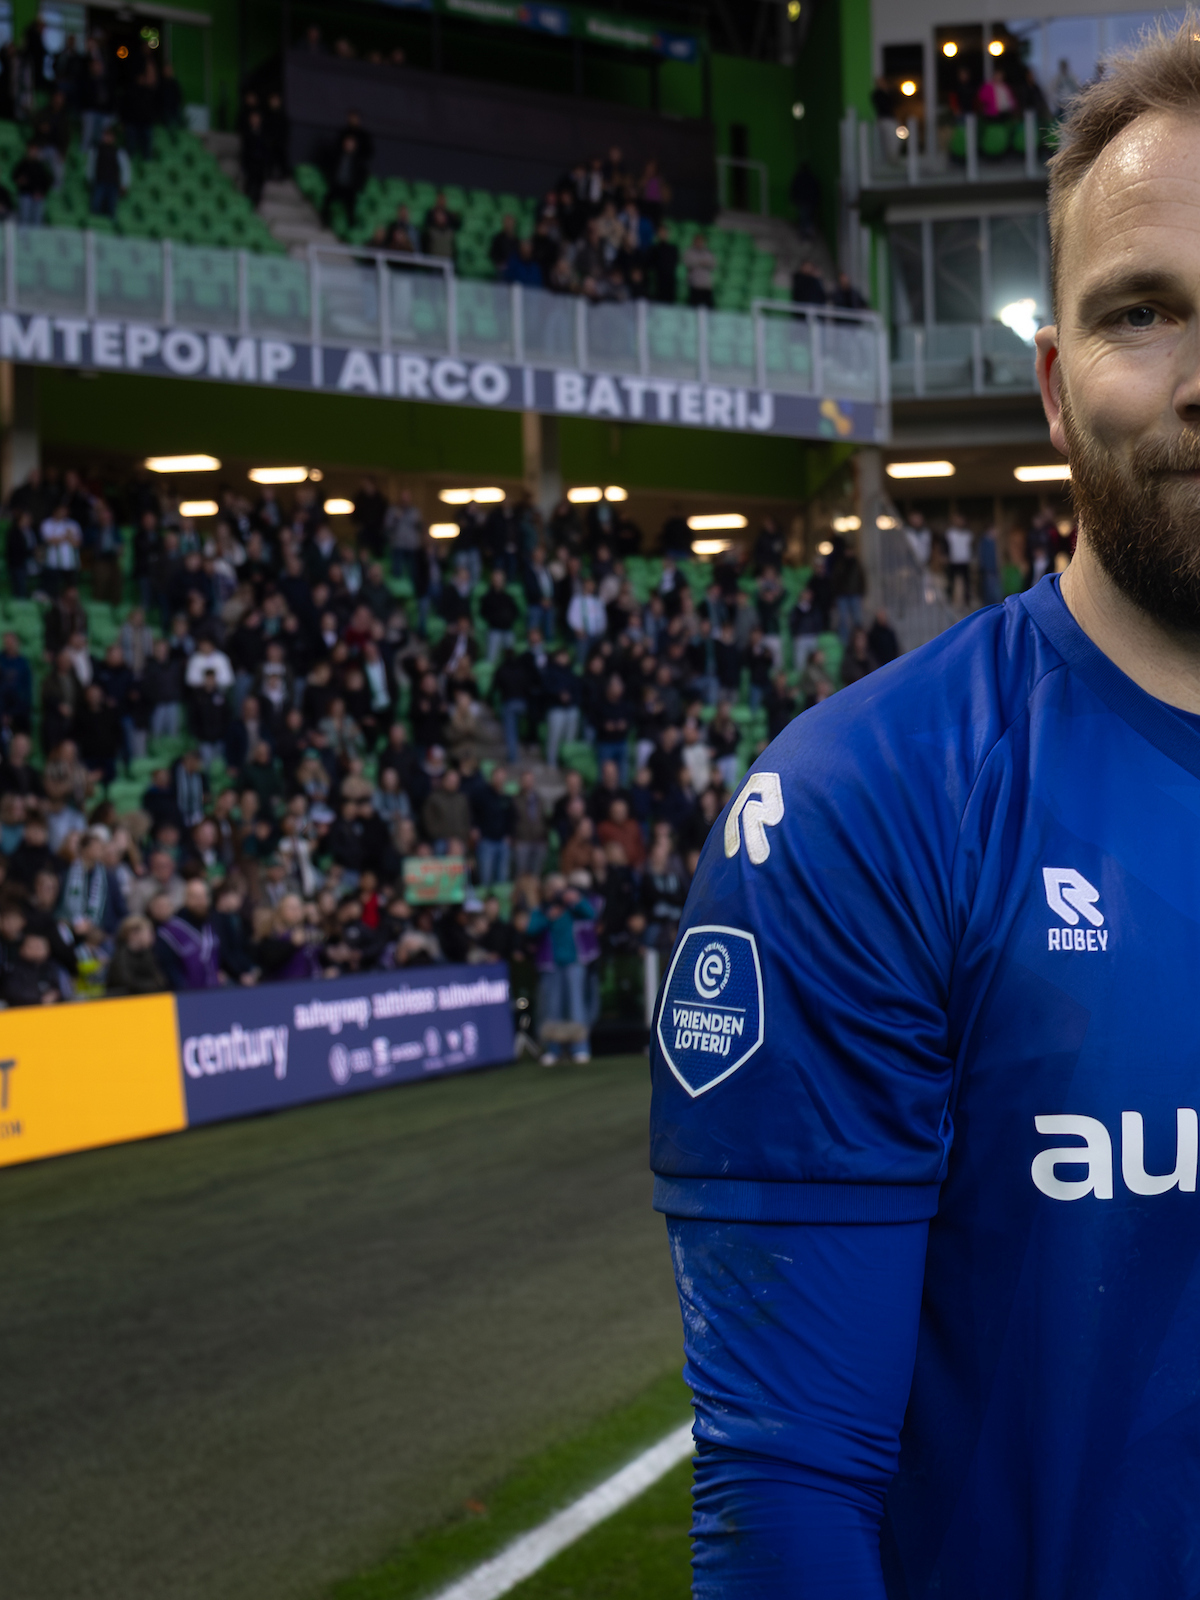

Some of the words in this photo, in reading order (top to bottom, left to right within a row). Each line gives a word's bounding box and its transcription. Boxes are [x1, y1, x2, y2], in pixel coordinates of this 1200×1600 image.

[0, 314, 295, 384] MTEPOMP
[337, 349, 509, 408] AIRCO
[553, 373, 775, 430] BATTERIJ
[1048, 928, 1108, 952] ROBEY
[673, 1008, 744, 1035] VRIENDEN
[183, 1022, 289, 1080] century
[674, 1029, 731, 1056] LOTERIJ
